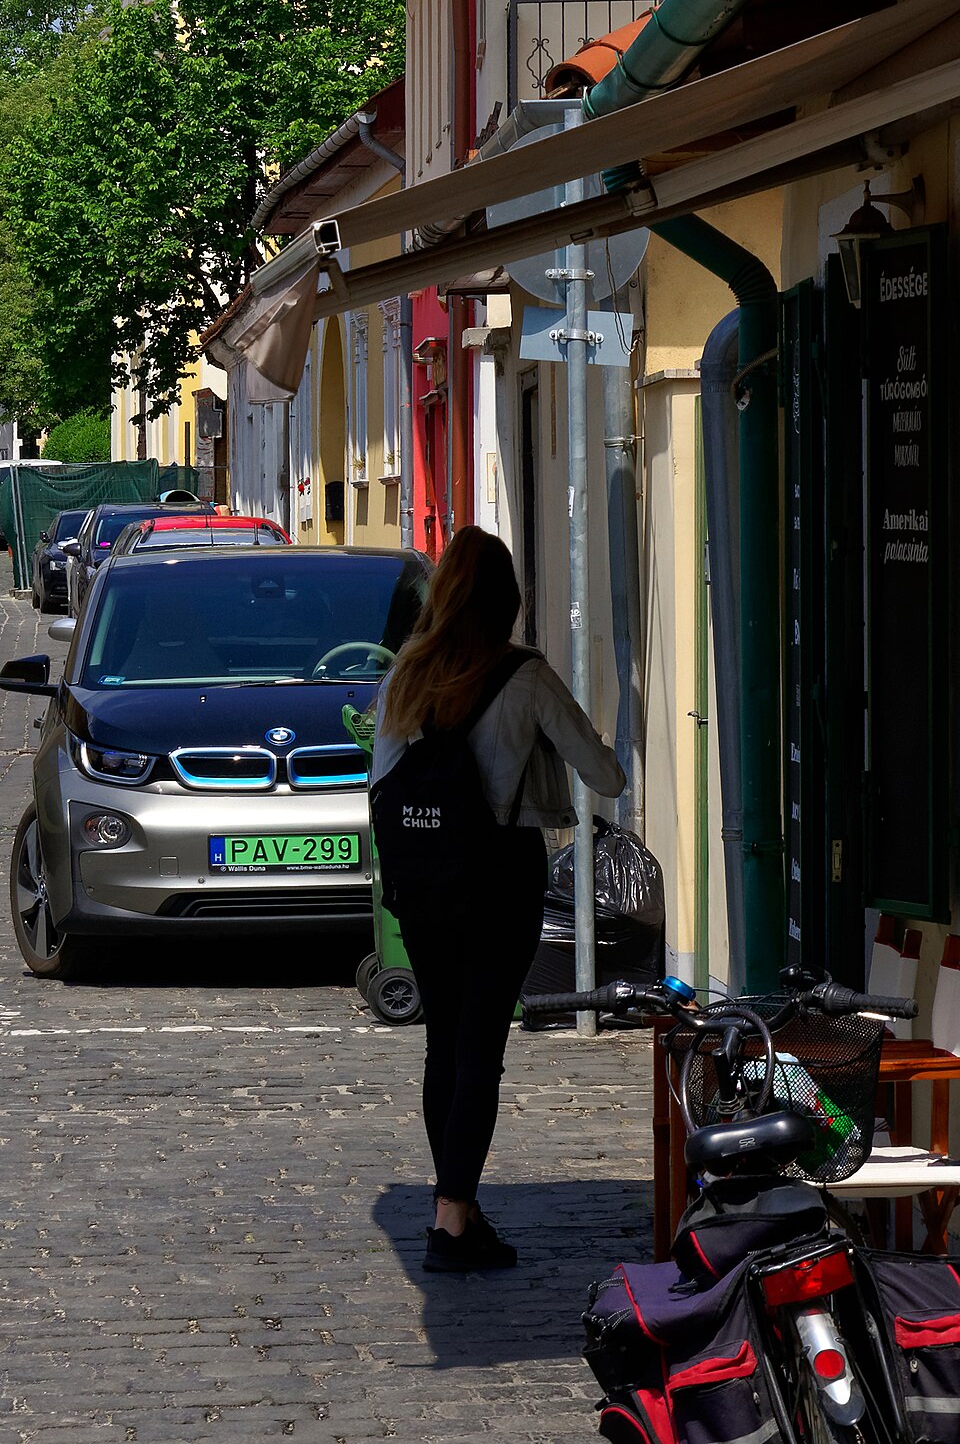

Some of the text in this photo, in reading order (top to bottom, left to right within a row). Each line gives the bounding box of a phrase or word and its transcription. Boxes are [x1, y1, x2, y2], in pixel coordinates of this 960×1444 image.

[896, 345, 917, 373] Sült
[882, 507, 929, 532] Amerikai
[883, 536, 929, 565] palacsinta
[402, 817, 441, 828] CHILD
[214, 853, 222, 862] H
[231, 836, 353, 863] PAV-299
